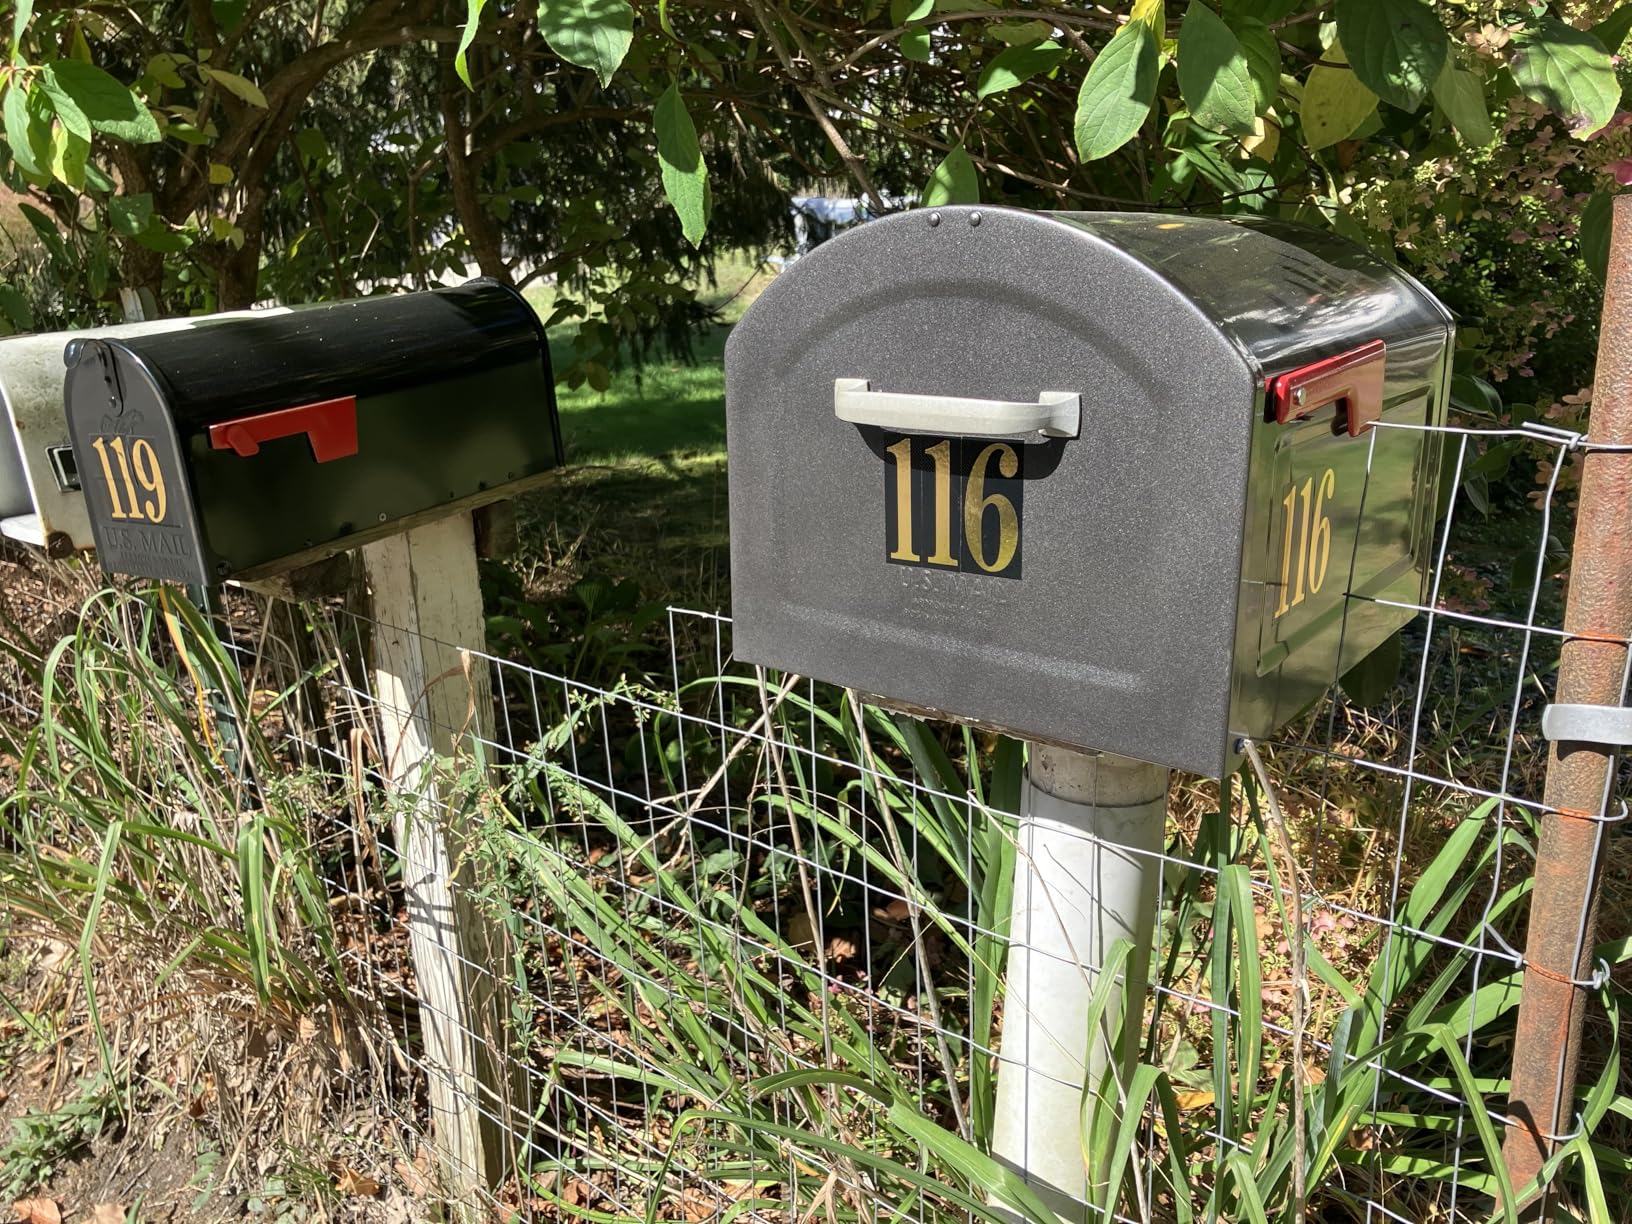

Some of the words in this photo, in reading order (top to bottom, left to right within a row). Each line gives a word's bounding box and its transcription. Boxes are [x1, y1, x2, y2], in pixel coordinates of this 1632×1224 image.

[92, 436, 167, 523] 119
[886, 437, 1019, 573] 116
[103, 526, 136, 550] U.S.
[138, 530, 191, 557] MAIL
[1274, 468, 1335, 618] 116
